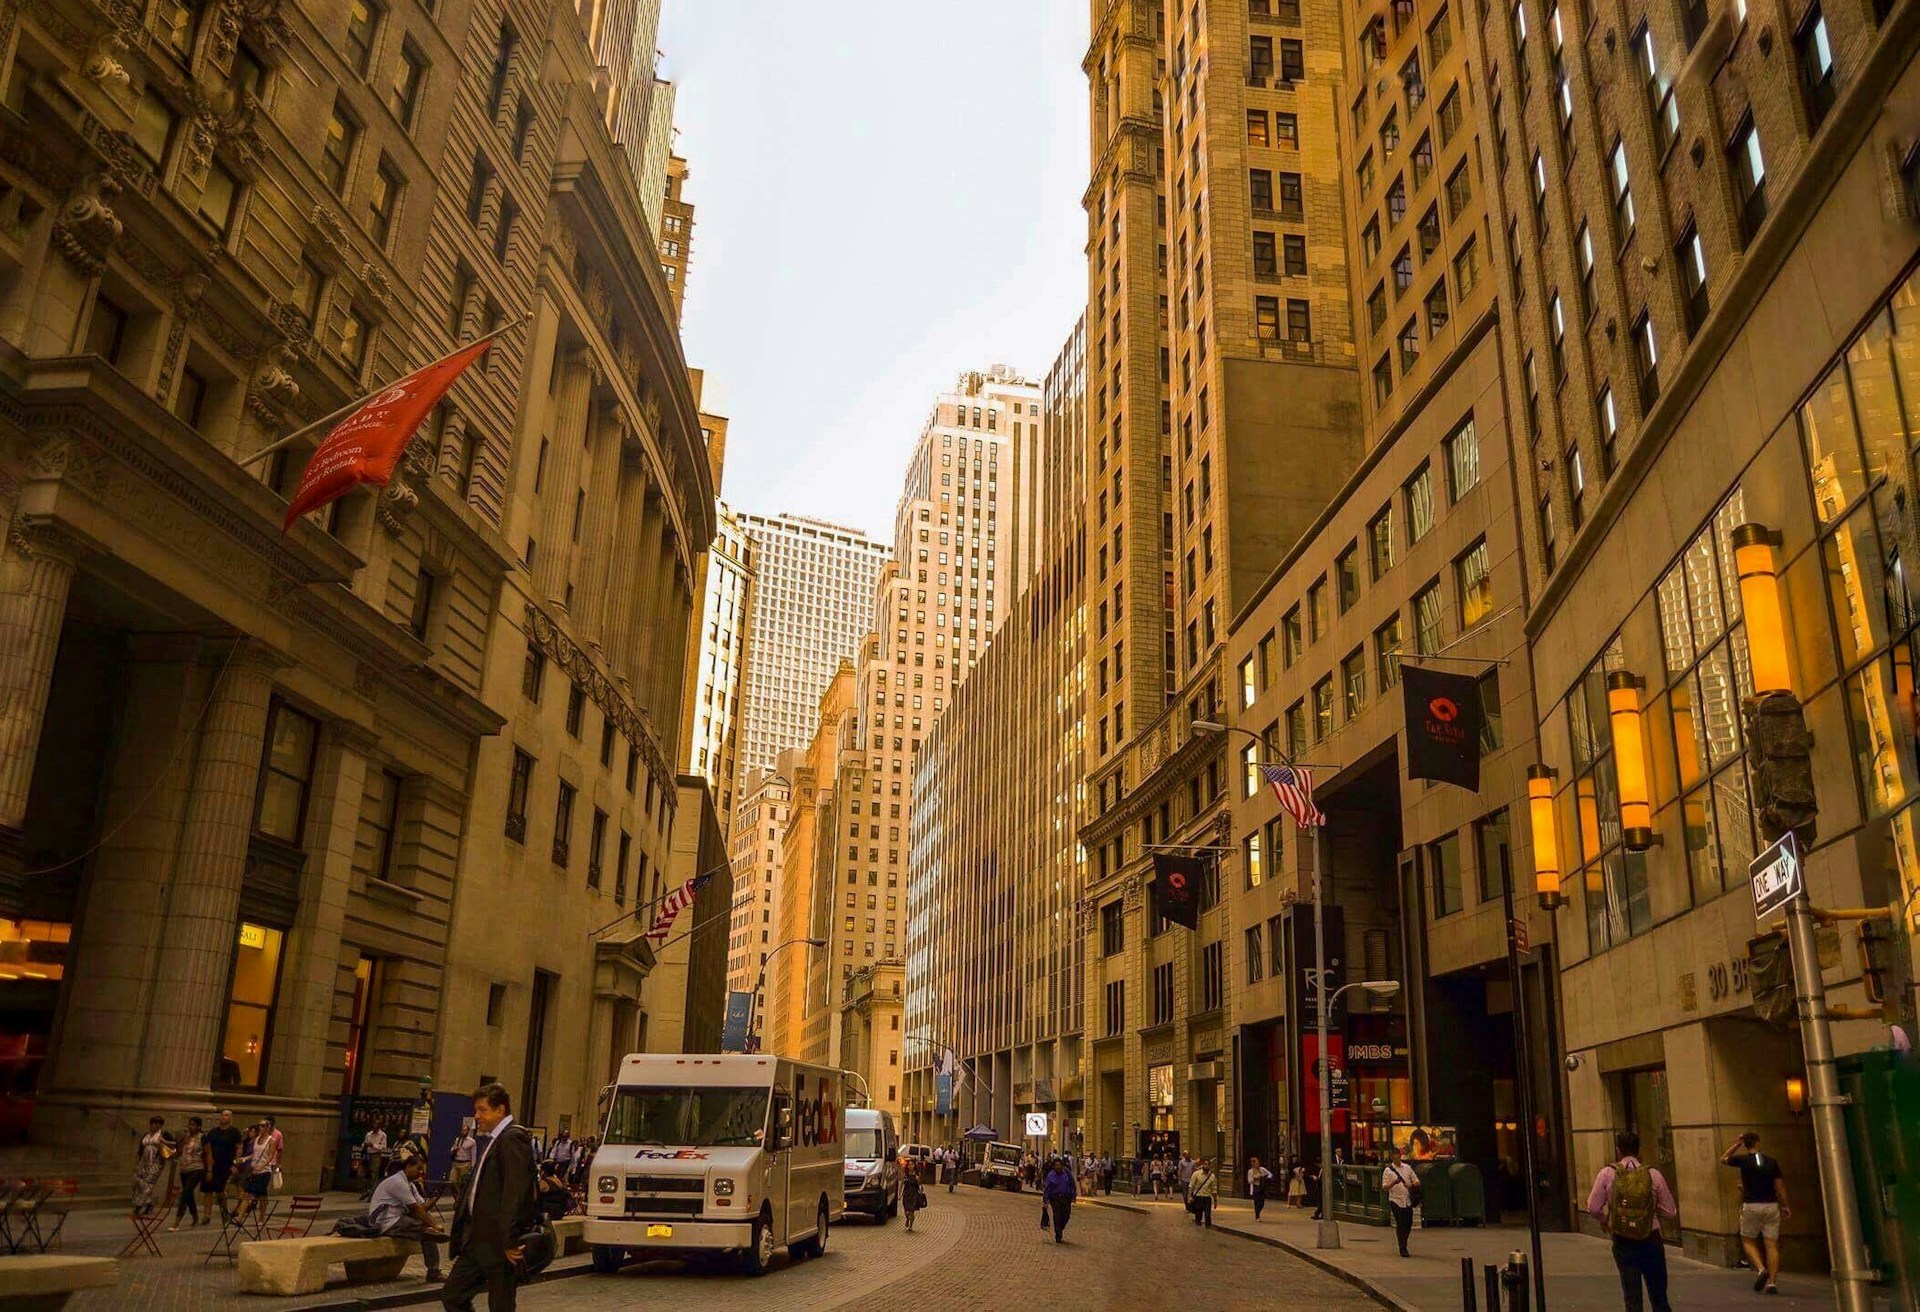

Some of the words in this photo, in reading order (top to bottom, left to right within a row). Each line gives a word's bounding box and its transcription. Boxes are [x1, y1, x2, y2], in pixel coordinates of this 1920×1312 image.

[323, 456, 358, 477] Rentals
[1755, 872, 1770, 898] ONE
[1773, 856, 1791, 886] WAY
[1708, 961, 1728, 1000] 30
[794, 1073, 838, 1148] FedEx
[635, 1149, 710, 1160] FedEx
[845, 1162, 867, 1172] Ex
